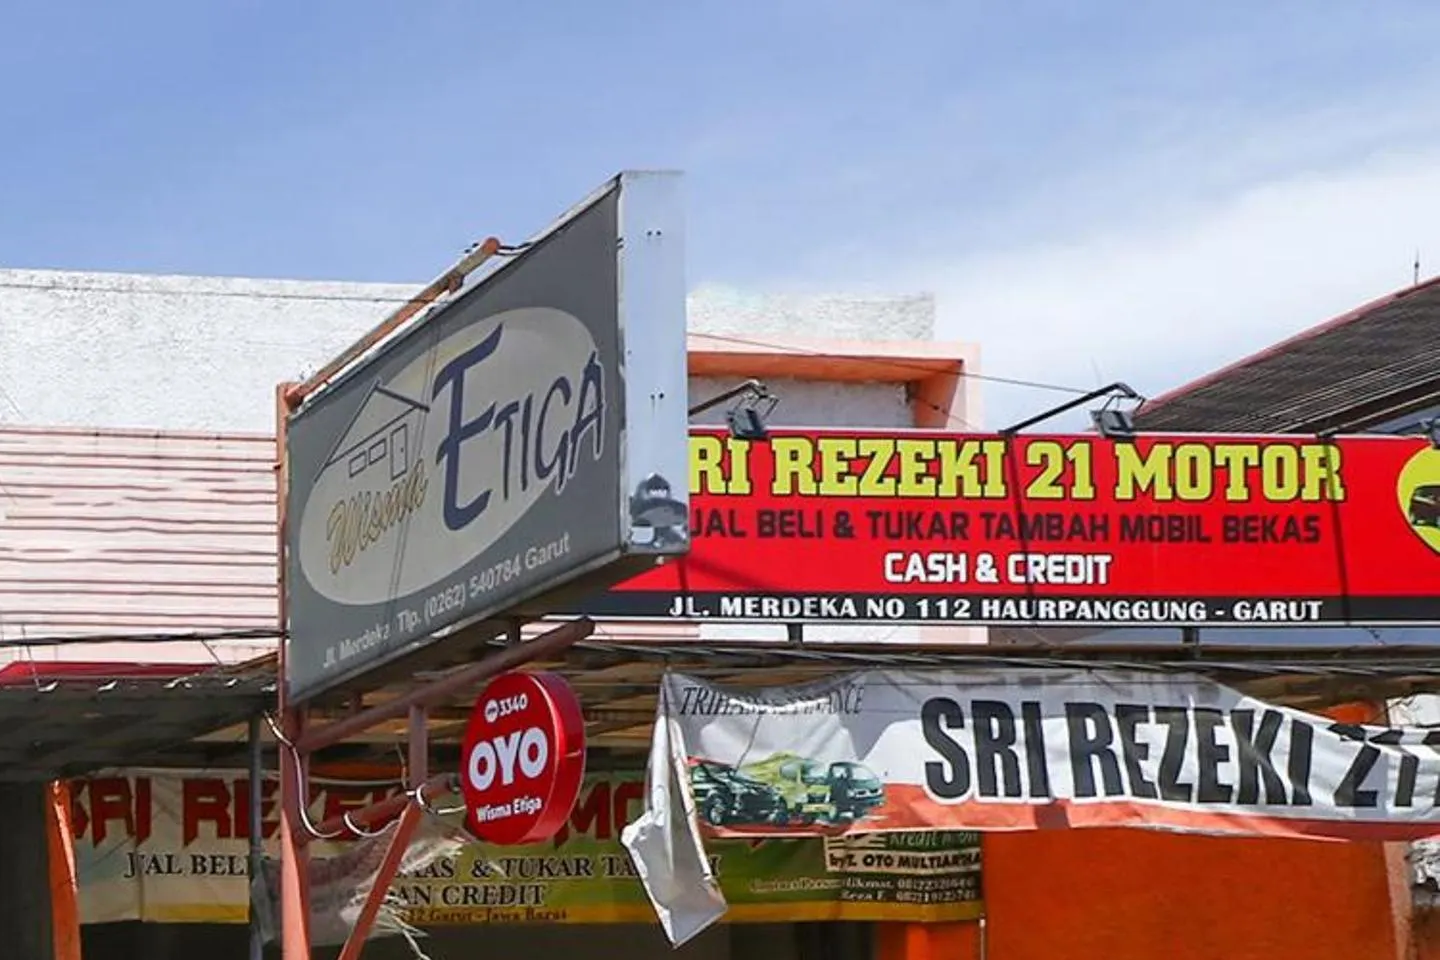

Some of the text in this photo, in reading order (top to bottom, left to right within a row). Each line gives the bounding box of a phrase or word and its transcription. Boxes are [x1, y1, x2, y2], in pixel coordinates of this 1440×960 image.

[688, 437, 1346, 501] RI REZEKI 21 MOTOR
[326, 459, 429, 576] Wisma
[690, 509, 1322, 544] JAL BELI & TUKAR TAMBAH MOBIL BEKAS
[424, 584, 466, 624] (0262)
[469, 558, 521, 599] 540784
[525, 532, 571, 571] Garut
[884, 553, 1111, 584] CASH & CREDIT
[669, 597, 709, 617] JL.
[720, 597, 858, 618] MERDEKA
[866, 598, 905, 618] NO
[916, 599, 971, 619] 112
[981, 599, 1207, 621] HAURPANGGUNG
[1233, 600, 1323, 621] GARUT
[499, 693, 528, 717] 3340
[468, 727, 548, 791] OYO
[921, 697, 1050, 798] SRI
[1064, 702, 1313, 806] REZEKI
[476, 804, 511, 823] Wisma
[472, 857, 490, 877] &
[503, 857, 592, 878] TUKAR
[863, 853, 894, 868] OTO
[442, 885, 545, 905] CREDIT
